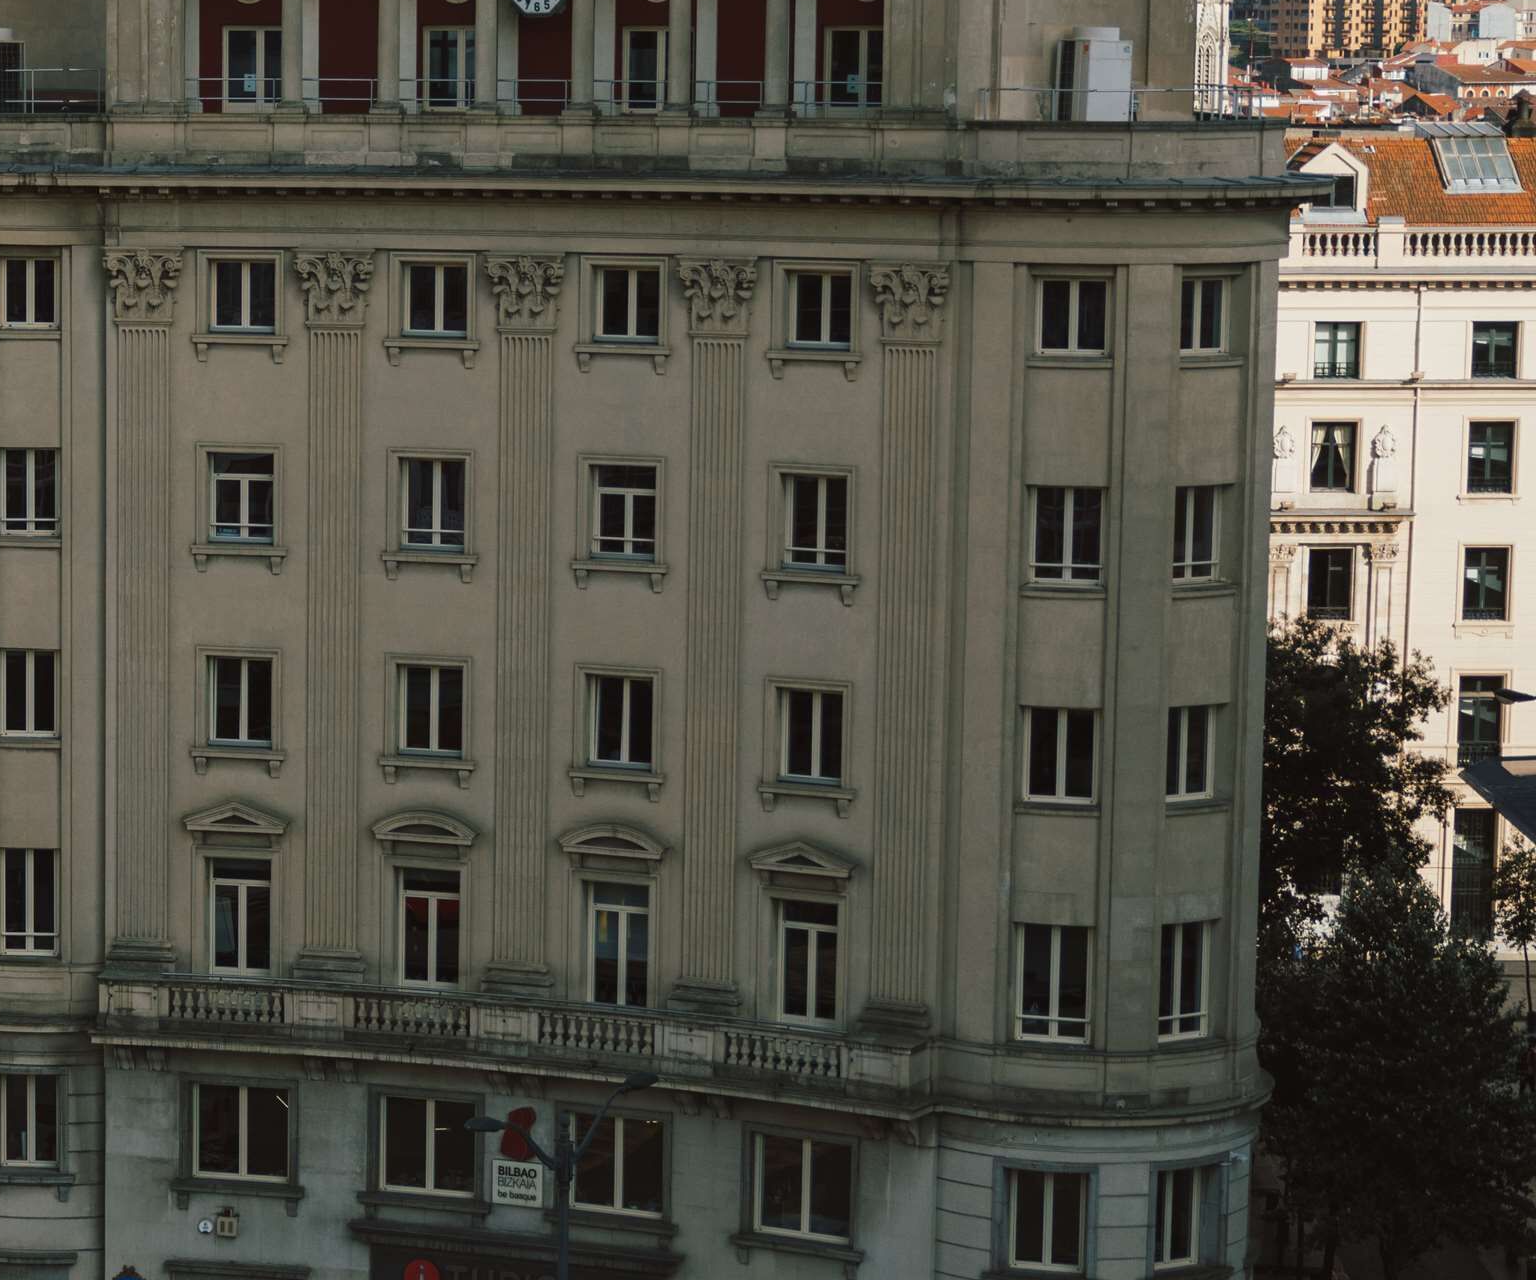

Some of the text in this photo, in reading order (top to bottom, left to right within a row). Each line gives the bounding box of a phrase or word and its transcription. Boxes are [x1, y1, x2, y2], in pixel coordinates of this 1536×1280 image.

[534, 1, 540, 12] 6
[544, 0, 550, 10] 5
[497, 1165, 537, 1179] BILBAO
[497, 1176, 537, 1190] BIZKAIA
[497, 1189, 537, 1202] be basque
